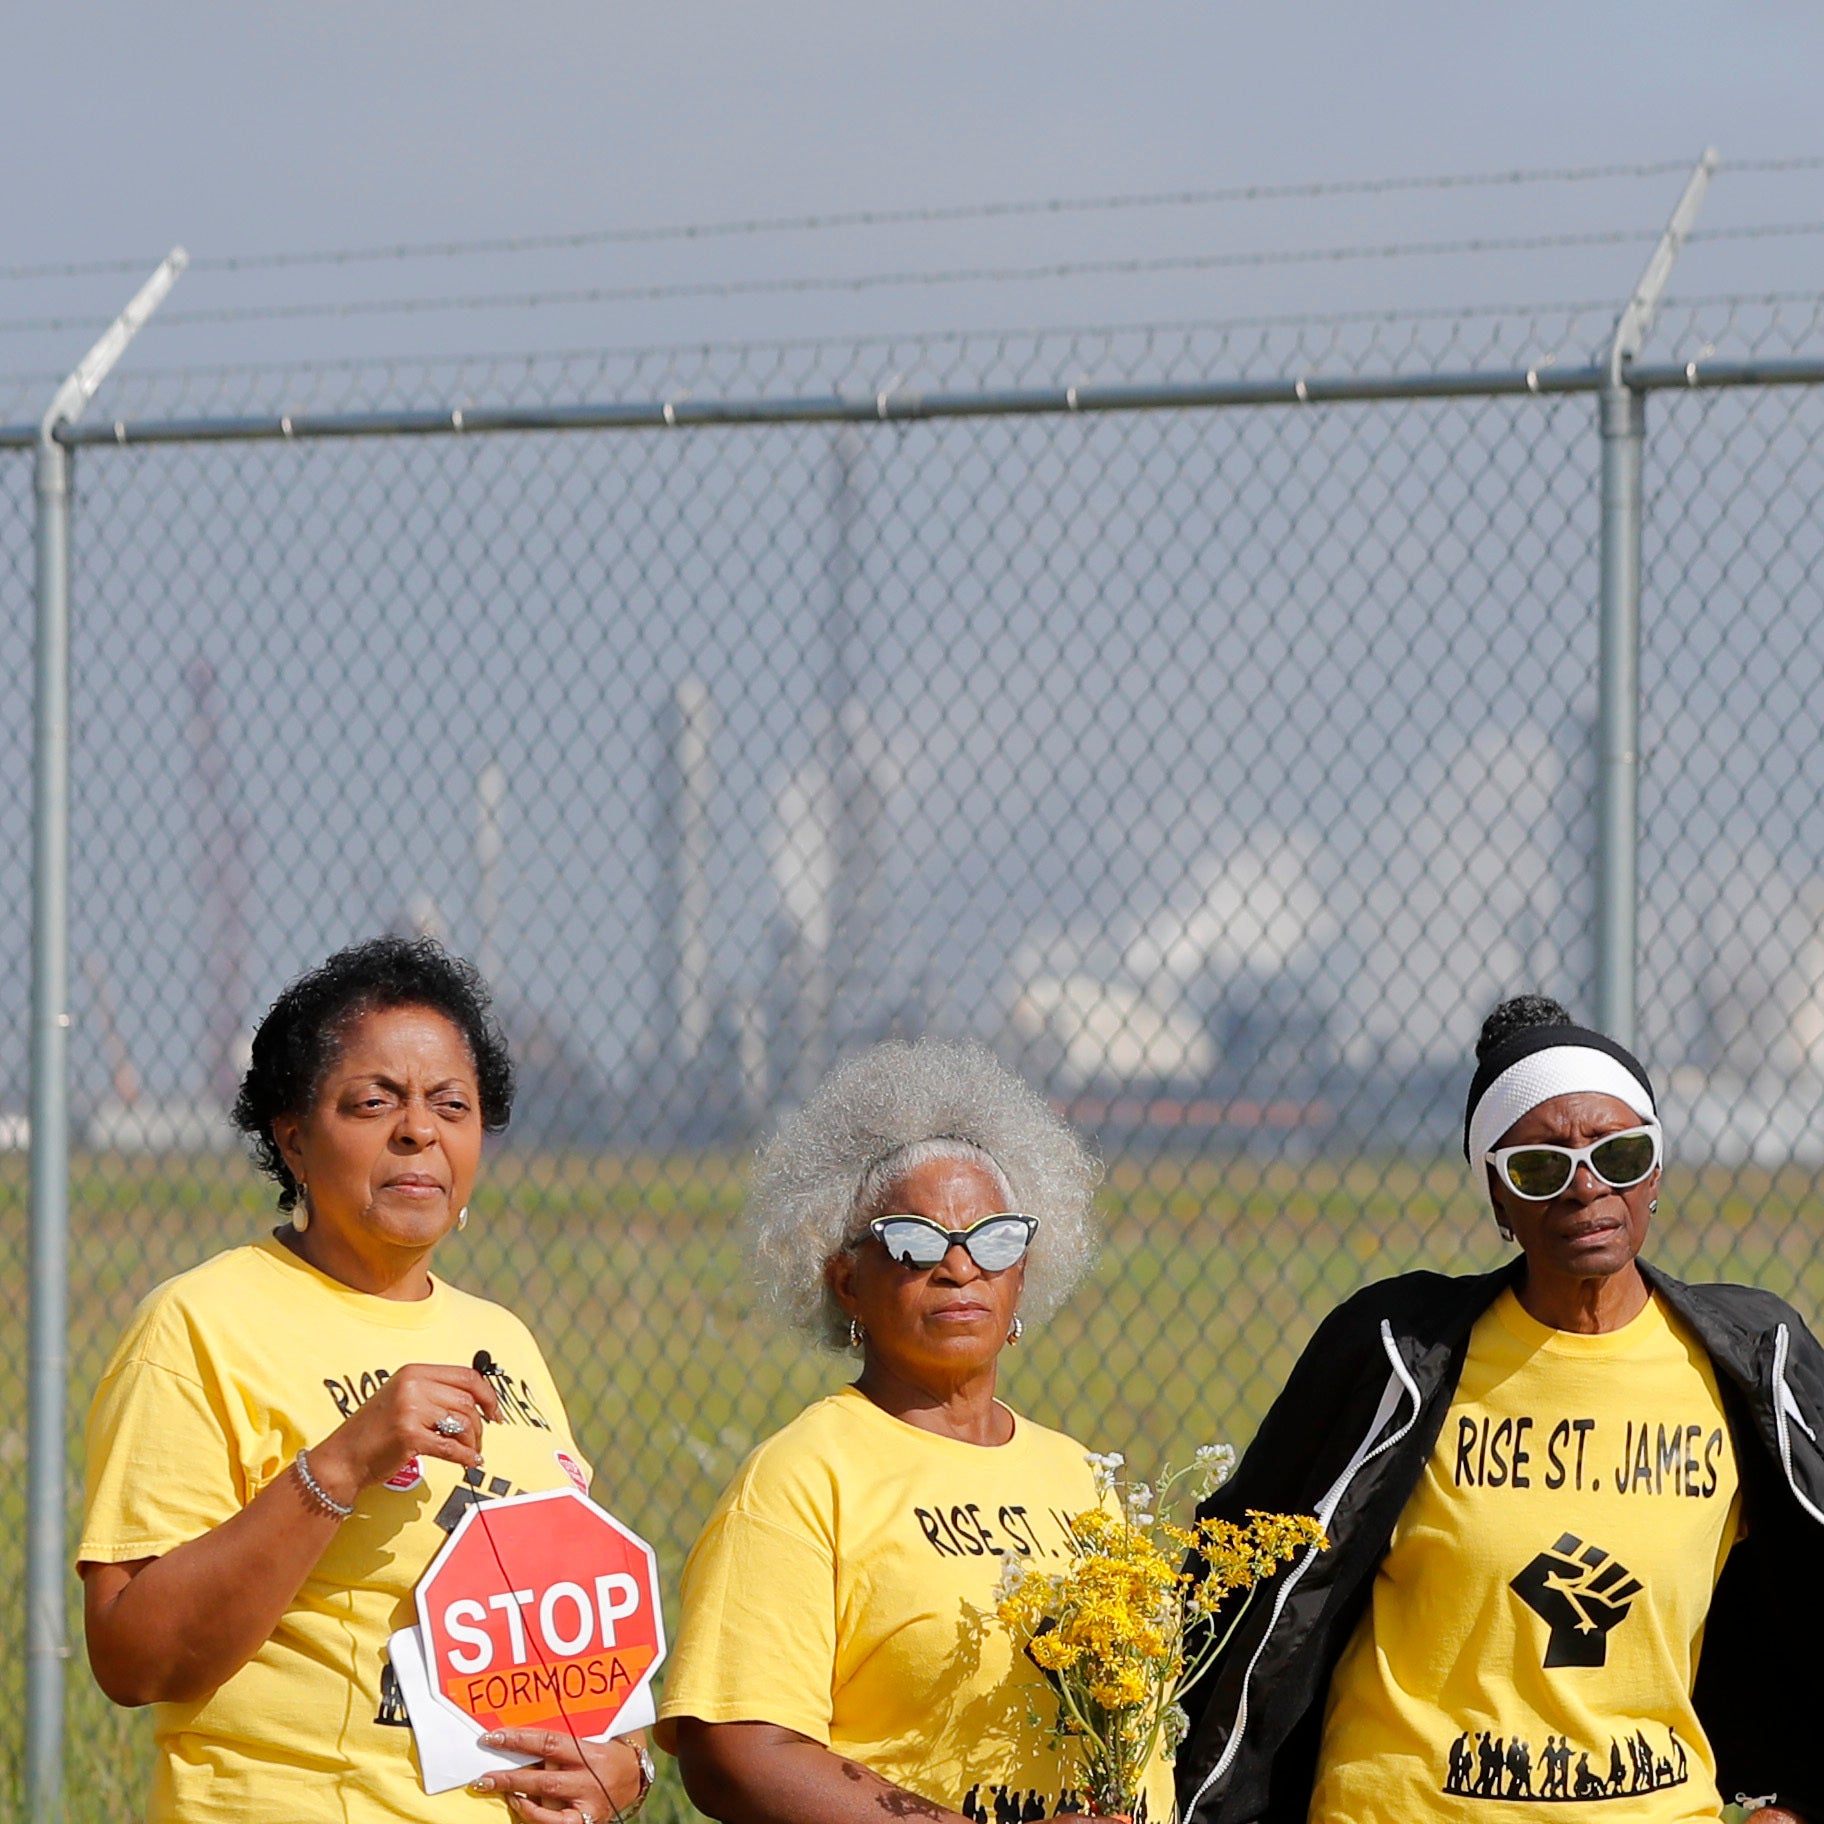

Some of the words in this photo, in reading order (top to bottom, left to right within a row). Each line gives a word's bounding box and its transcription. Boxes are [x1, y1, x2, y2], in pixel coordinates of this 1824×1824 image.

[478, 1374, 553, 1433] MES
[1454, 1415, 1534, 1489] RISE
[1544, 1417, 1601, 1491] ST.
[1614, 1419, 1723, 1499] JAMES
[913, 1503, 1005, 1558] RISE
[998, 1505, 1060, 1558] ST.
[443, 1572, 641, 1675] STOP
[467, 1657, 632, 1714] FORMOSA
